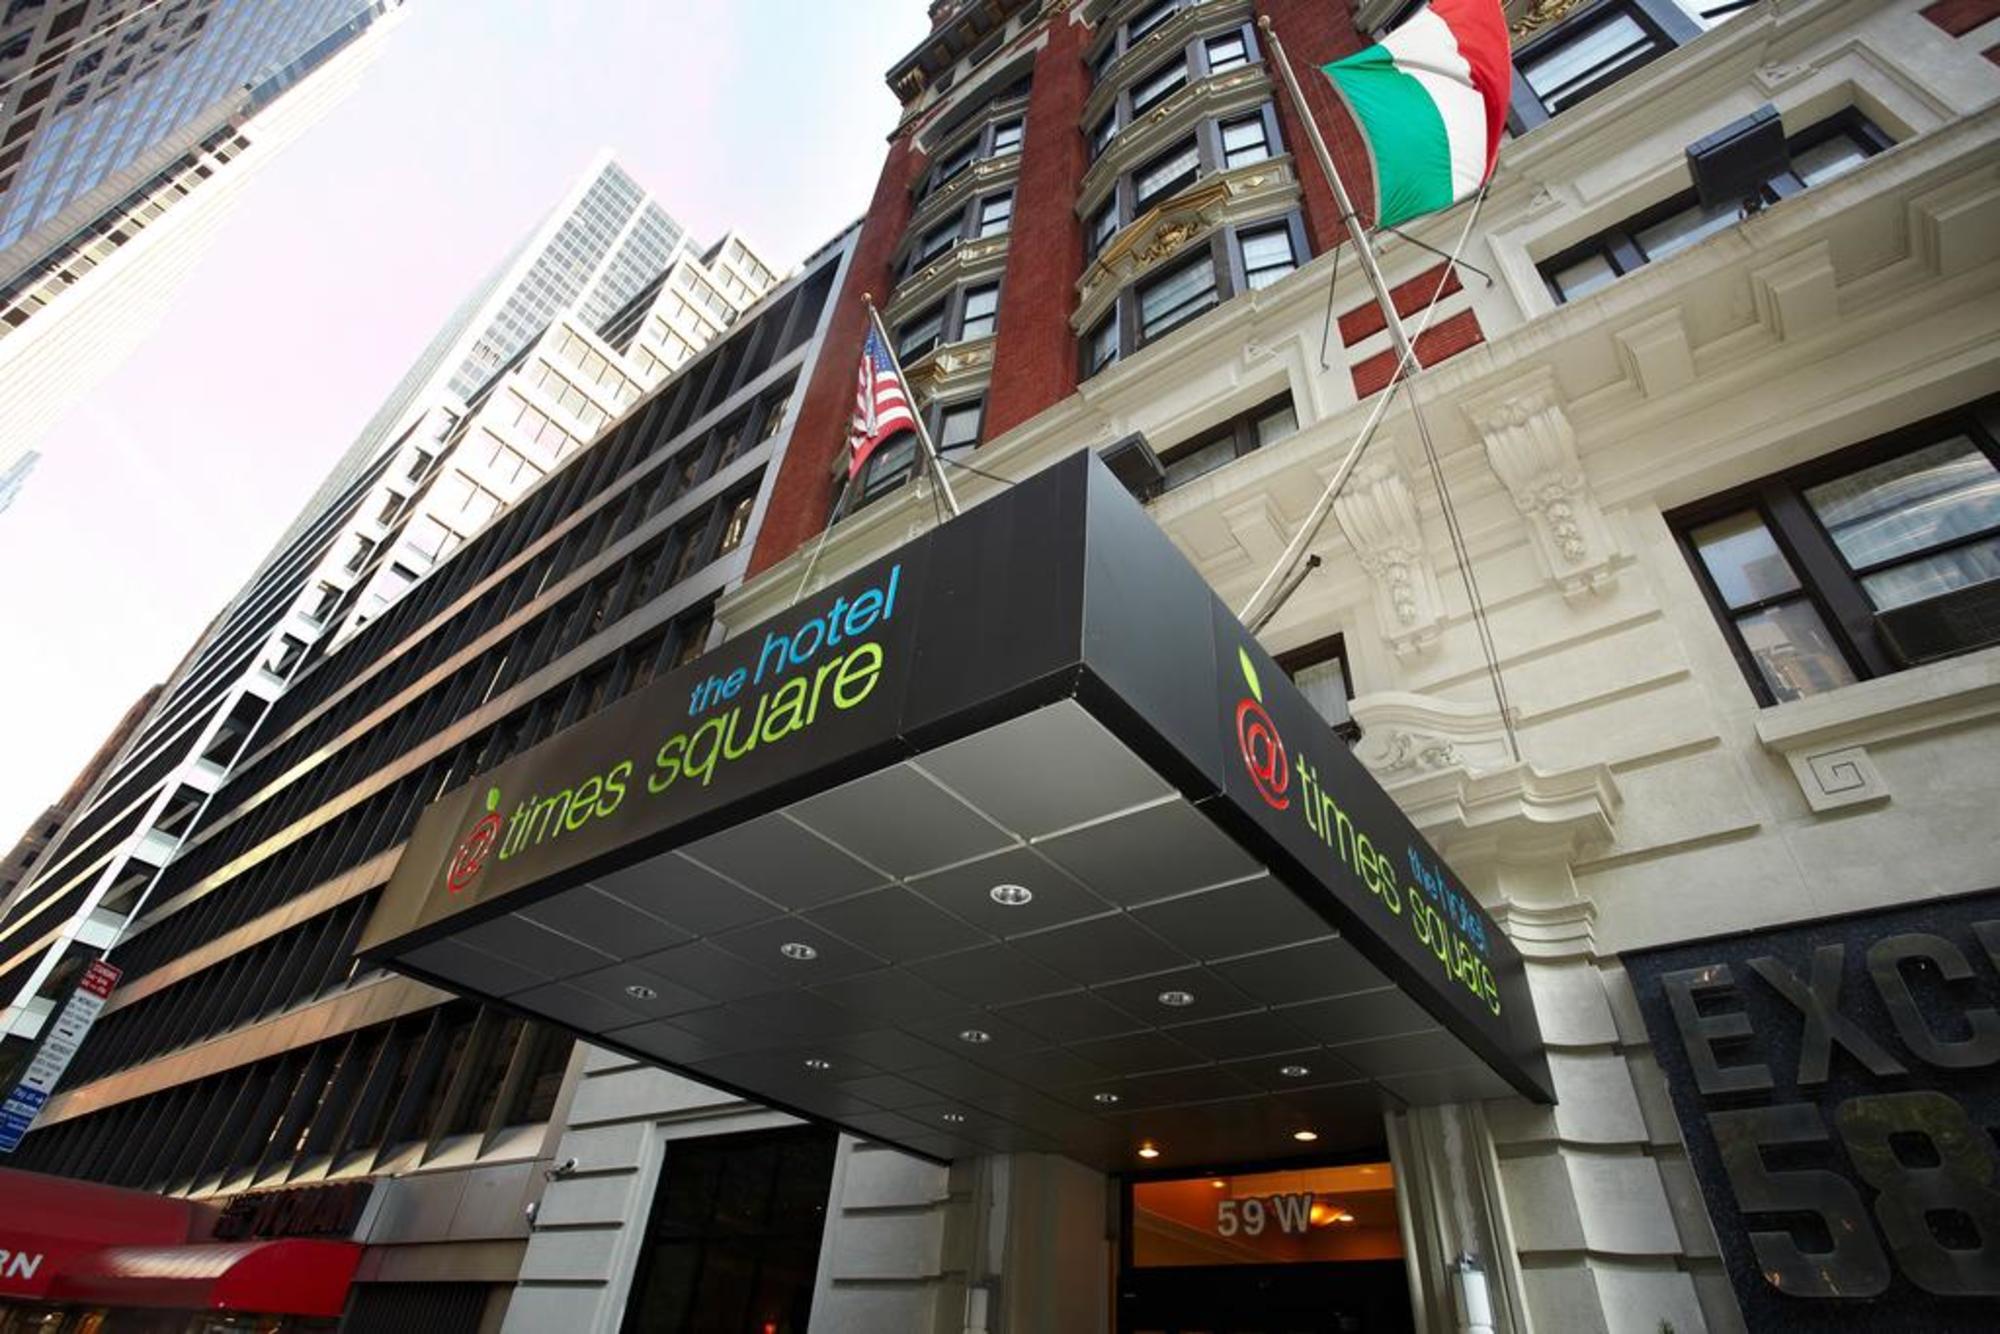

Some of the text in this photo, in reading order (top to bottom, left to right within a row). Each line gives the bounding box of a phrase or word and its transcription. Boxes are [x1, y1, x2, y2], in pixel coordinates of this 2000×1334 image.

[687, 565, 901, 716] the hotel
[499, 760, 634, 860] times
[648, 642, 884, 793] square
[1235, 698, 1501, 1017] @ times square
[1661, 920, 2000, 1095] EXC
[1217, 1195, 1312, 1237] 59 W
[1706, 1090, 2000, 1297] 58
